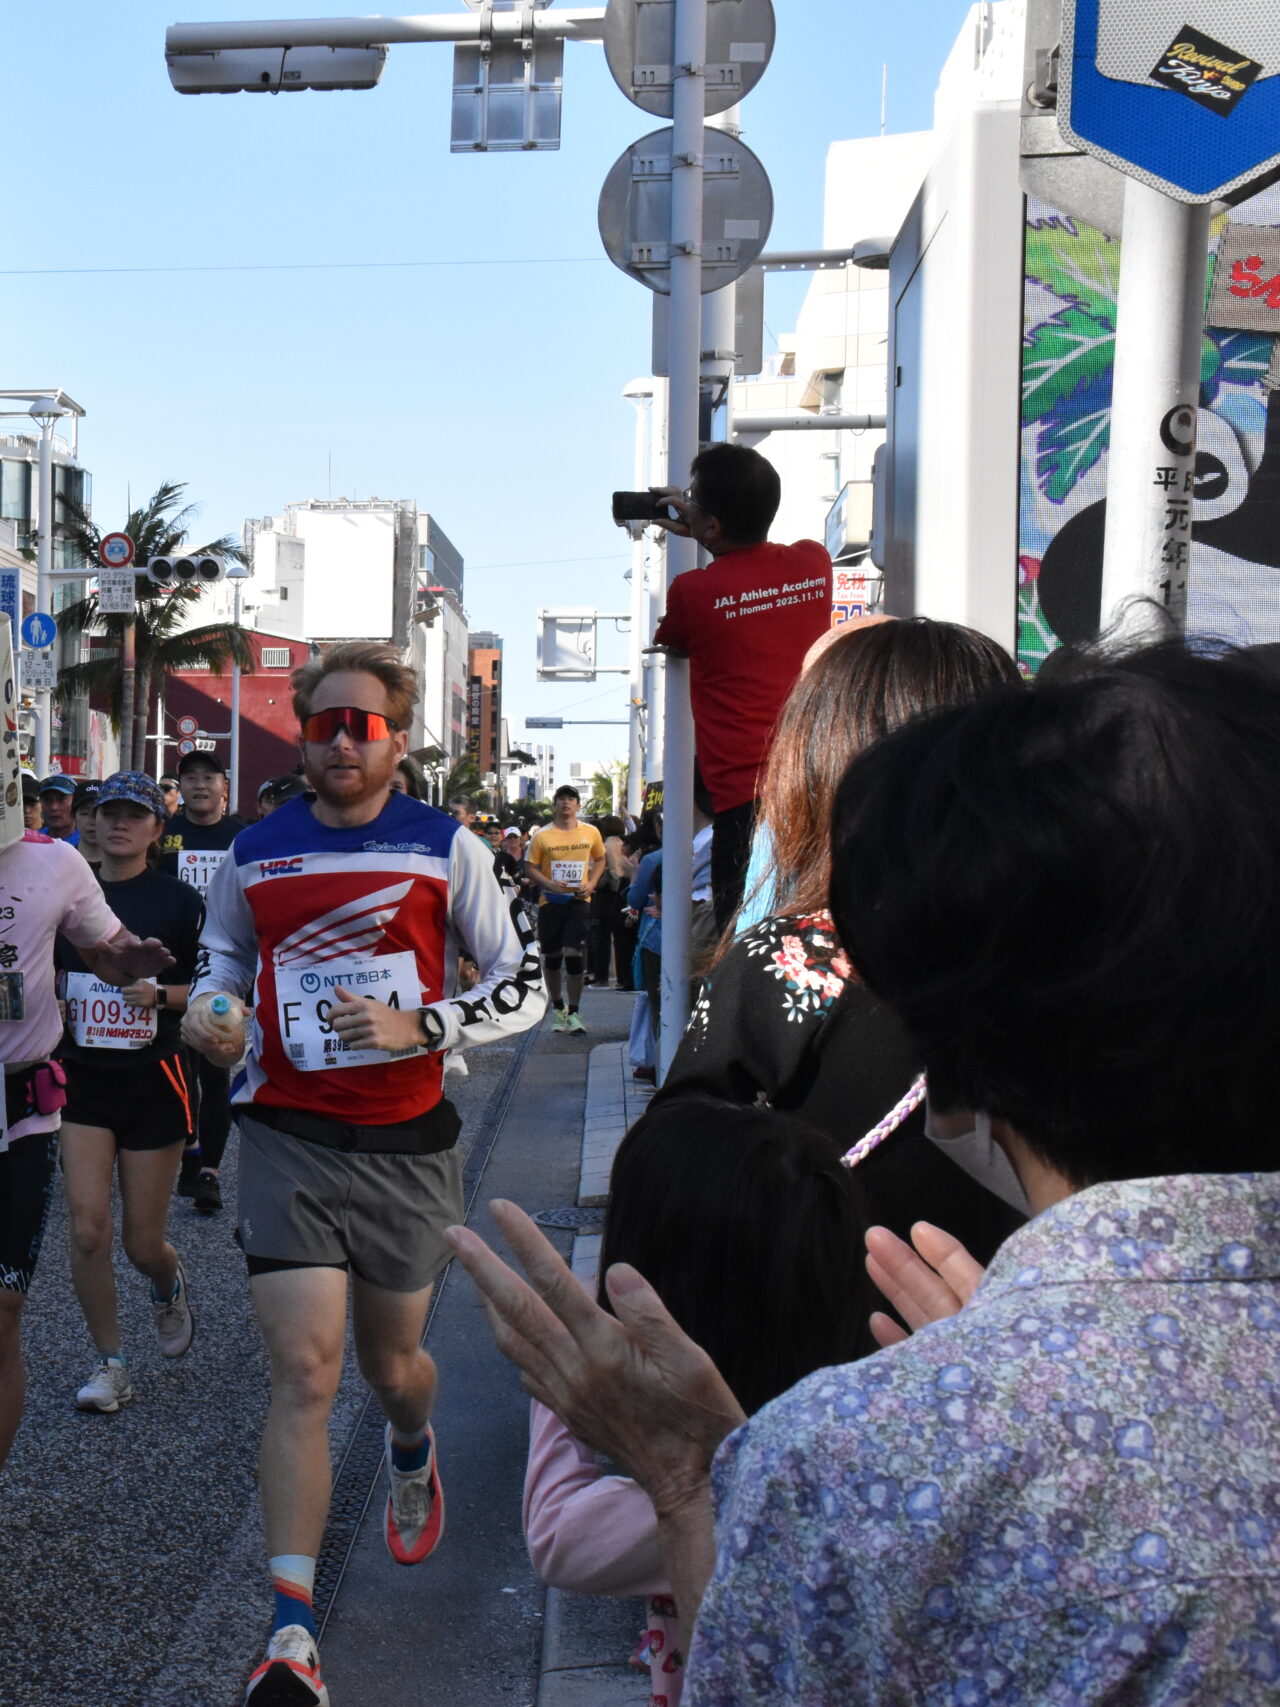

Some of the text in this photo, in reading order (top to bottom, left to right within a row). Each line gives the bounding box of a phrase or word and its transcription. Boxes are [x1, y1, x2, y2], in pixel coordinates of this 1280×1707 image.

[836, 573, 866, 590] 免税
[714, 577, 826, 609] JAL Athlete Academy
[725, 590, 824, 619] in Itoman 2025.11.16
[164, 834, 184, 850] 39
[180, 867, 217, 884] G11
[259, 857, 304, 878] HRC
[561, 870, 582, 879] 7497
[89, 983, 114, 994] ANA
[69, 997, 152, 1026] G10934
[283, 1001, 302, 1038] F
